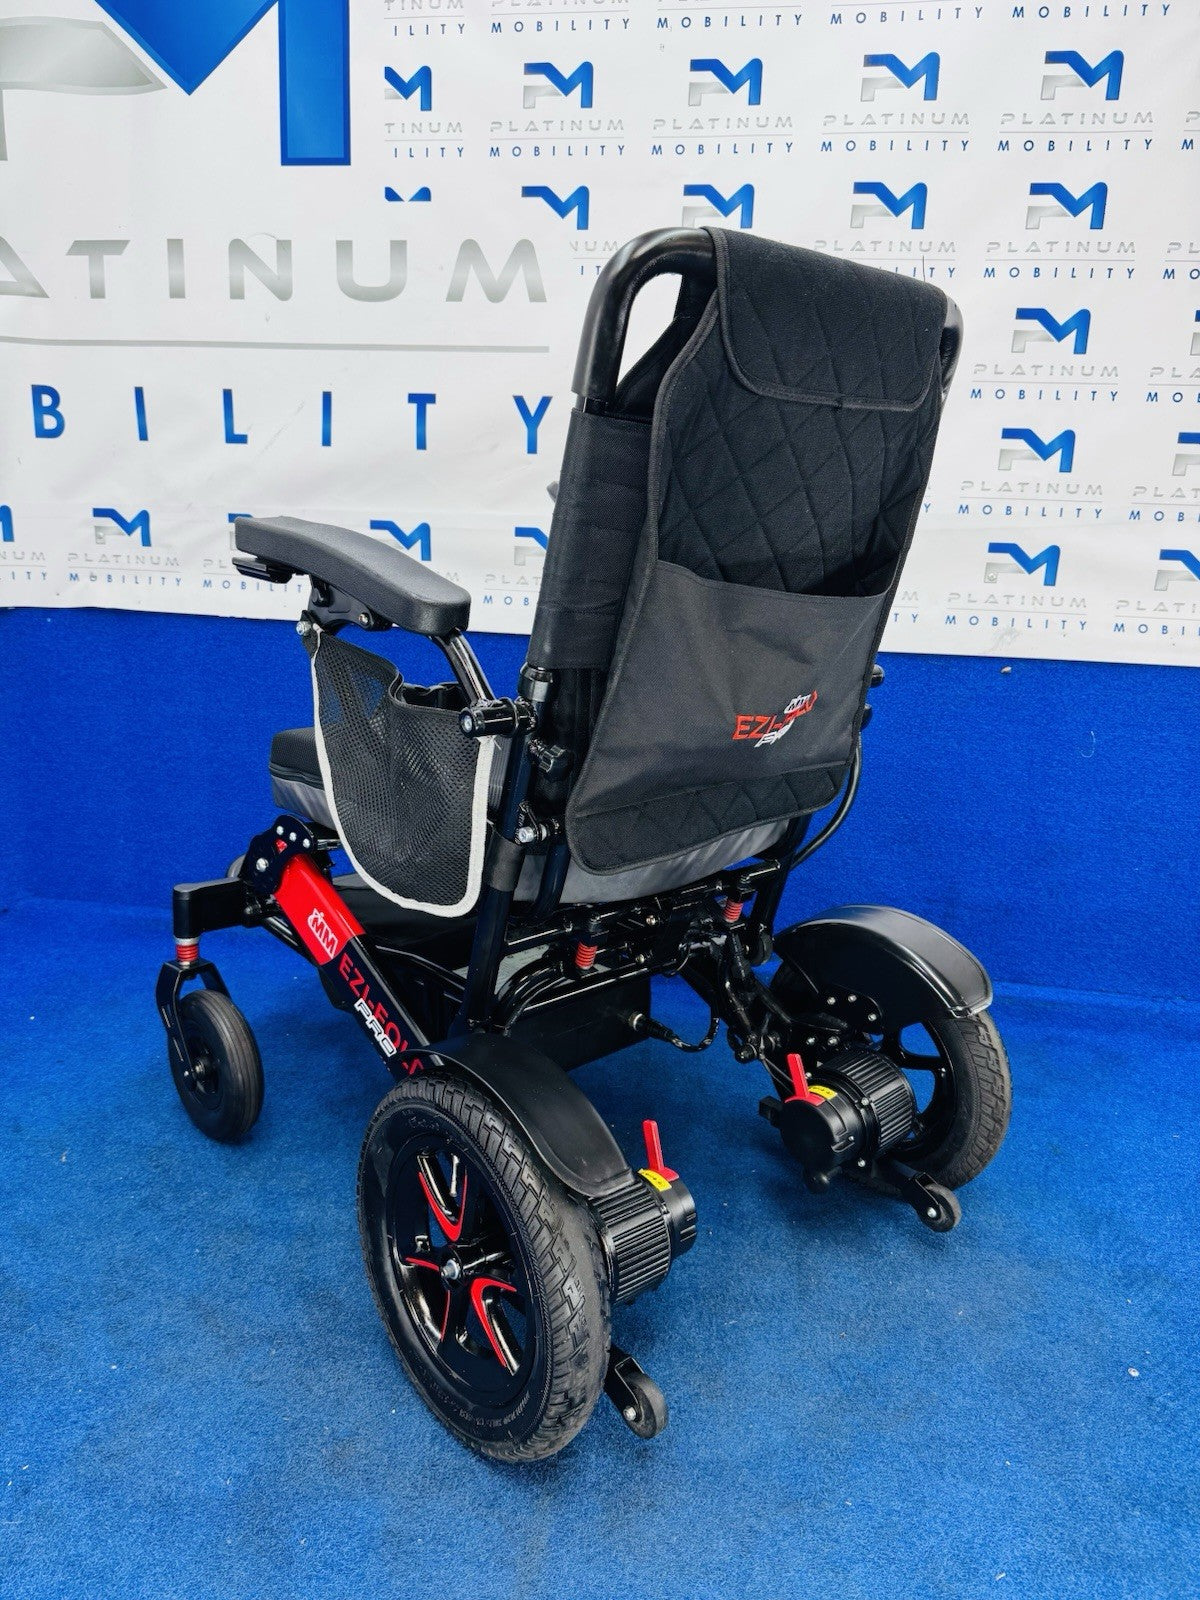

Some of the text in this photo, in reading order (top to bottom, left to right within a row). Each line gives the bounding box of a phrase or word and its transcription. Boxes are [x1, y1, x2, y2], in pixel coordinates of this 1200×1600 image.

[830, 6, 983, 25] MOBILITY
[1012, 3, 1171, 19] MOBILITY
[491, 18, 630, 34] MOBILITY
[656, 14, 802, 29] MOBILITY
[394, 23, 465, 37] ILITY
[653, 116, 792, 130] PLATINUM
[823, 112, 969, 126] PLATINUM
[1001, 111, 1153, 125] PLATINUM
[384, 122, 462, 134] TINUM
[490, 119, 624, 132] PLATINUM
[489, 144, 626, 158] MOBILITY
[651, 142, 794, 156] MOBILITY
[820, 140, 971, 152] MOBILITY
[998, 138, 1153, 152] MOBILITY
[394, 147, 465, 159] ILITY
[813, 240, 956, 253] PLATINUM
[987, 240, 1136, 254] PLATINUM
[983, 267, 1136, 280] MOBILITY
[974, 363, 1118, 377] PLATINUM
[970, 388, 1119, 401] MOBILITY
[31, 384, 552, 455] BILITY
[961, 481, 1103, 495] PLATINUM
[957, 504, 1103, 519] MOBILITY
[67, 552, 180, 566] PLATINUM
[948, 592, 1088, 608] PLATINUM
[945, 615, 1088, 631] MOBILITY
[353, 996, 397, 1058] PRO
